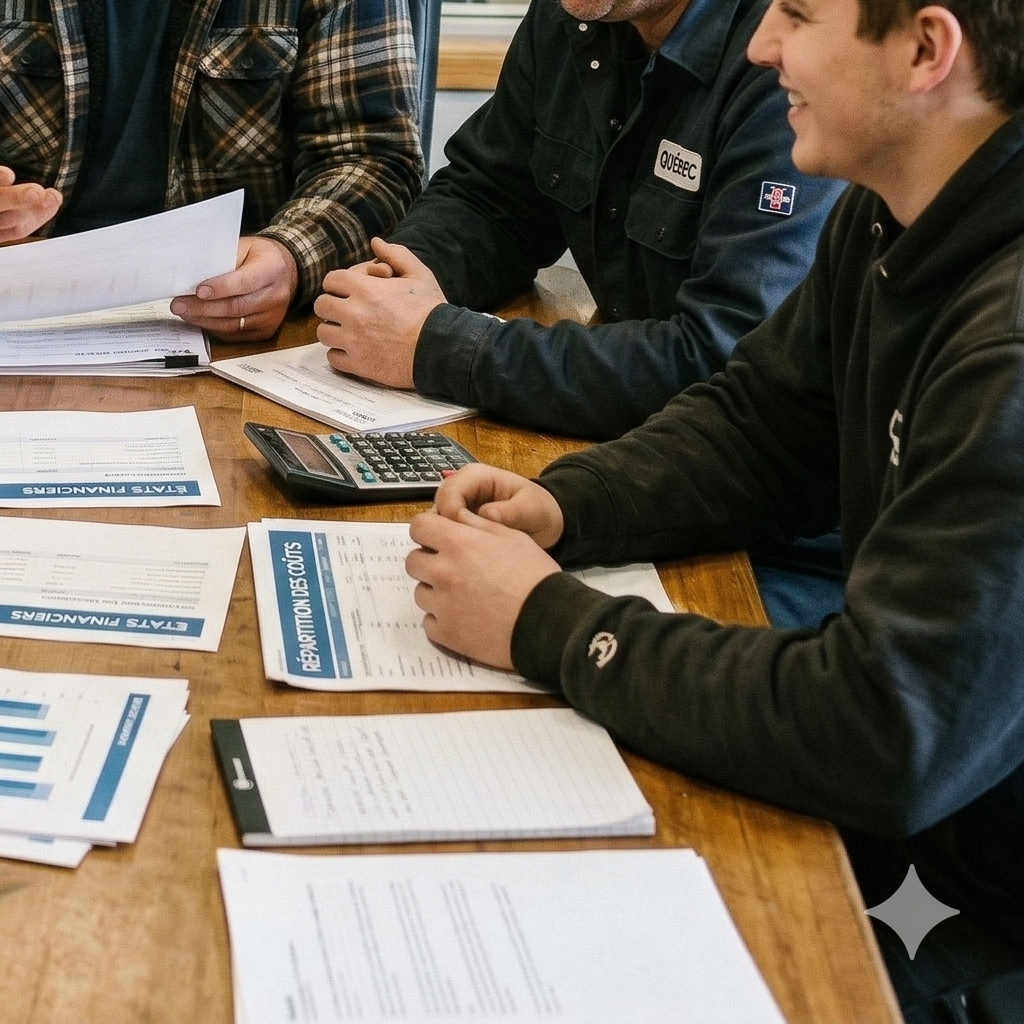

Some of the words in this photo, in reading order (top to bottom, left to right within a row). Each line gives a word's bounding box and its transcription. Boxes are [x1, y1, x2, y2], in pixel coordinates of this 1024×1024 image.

[660, 150, 698, 180] QUÉBEC
[22, 485, 126, 495] FINANCIERS
[10, 610, 121, 627] FINANCIERS
[292, 598, 322, 672] RÉPARTITION
